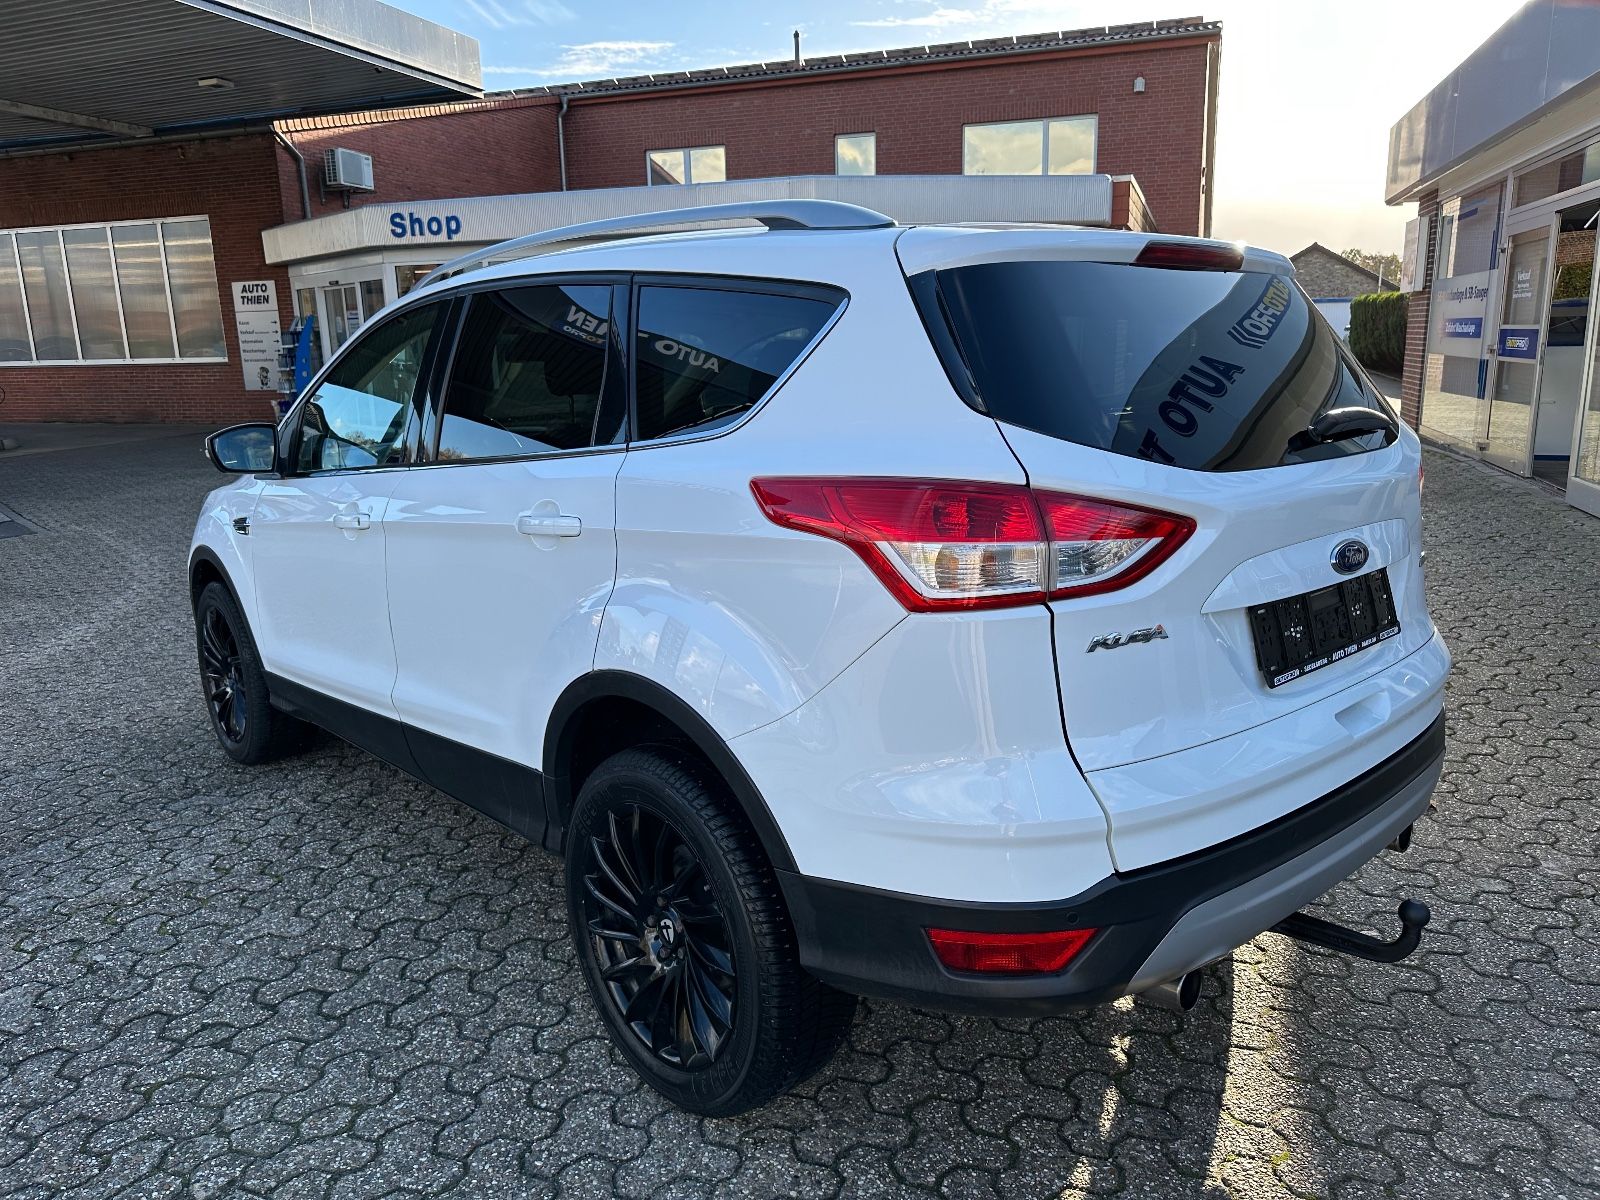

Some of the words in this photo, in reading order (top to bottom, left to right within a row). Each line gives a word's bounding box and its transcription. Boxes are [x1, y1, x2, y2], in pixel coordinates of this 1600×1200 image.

[389, 213, 462, 239] Shop
[241, 284, 267, 294] AUTO
[241, 295, 269, 305] THIEN
[1085, 624, 1169, 653] KUGA
